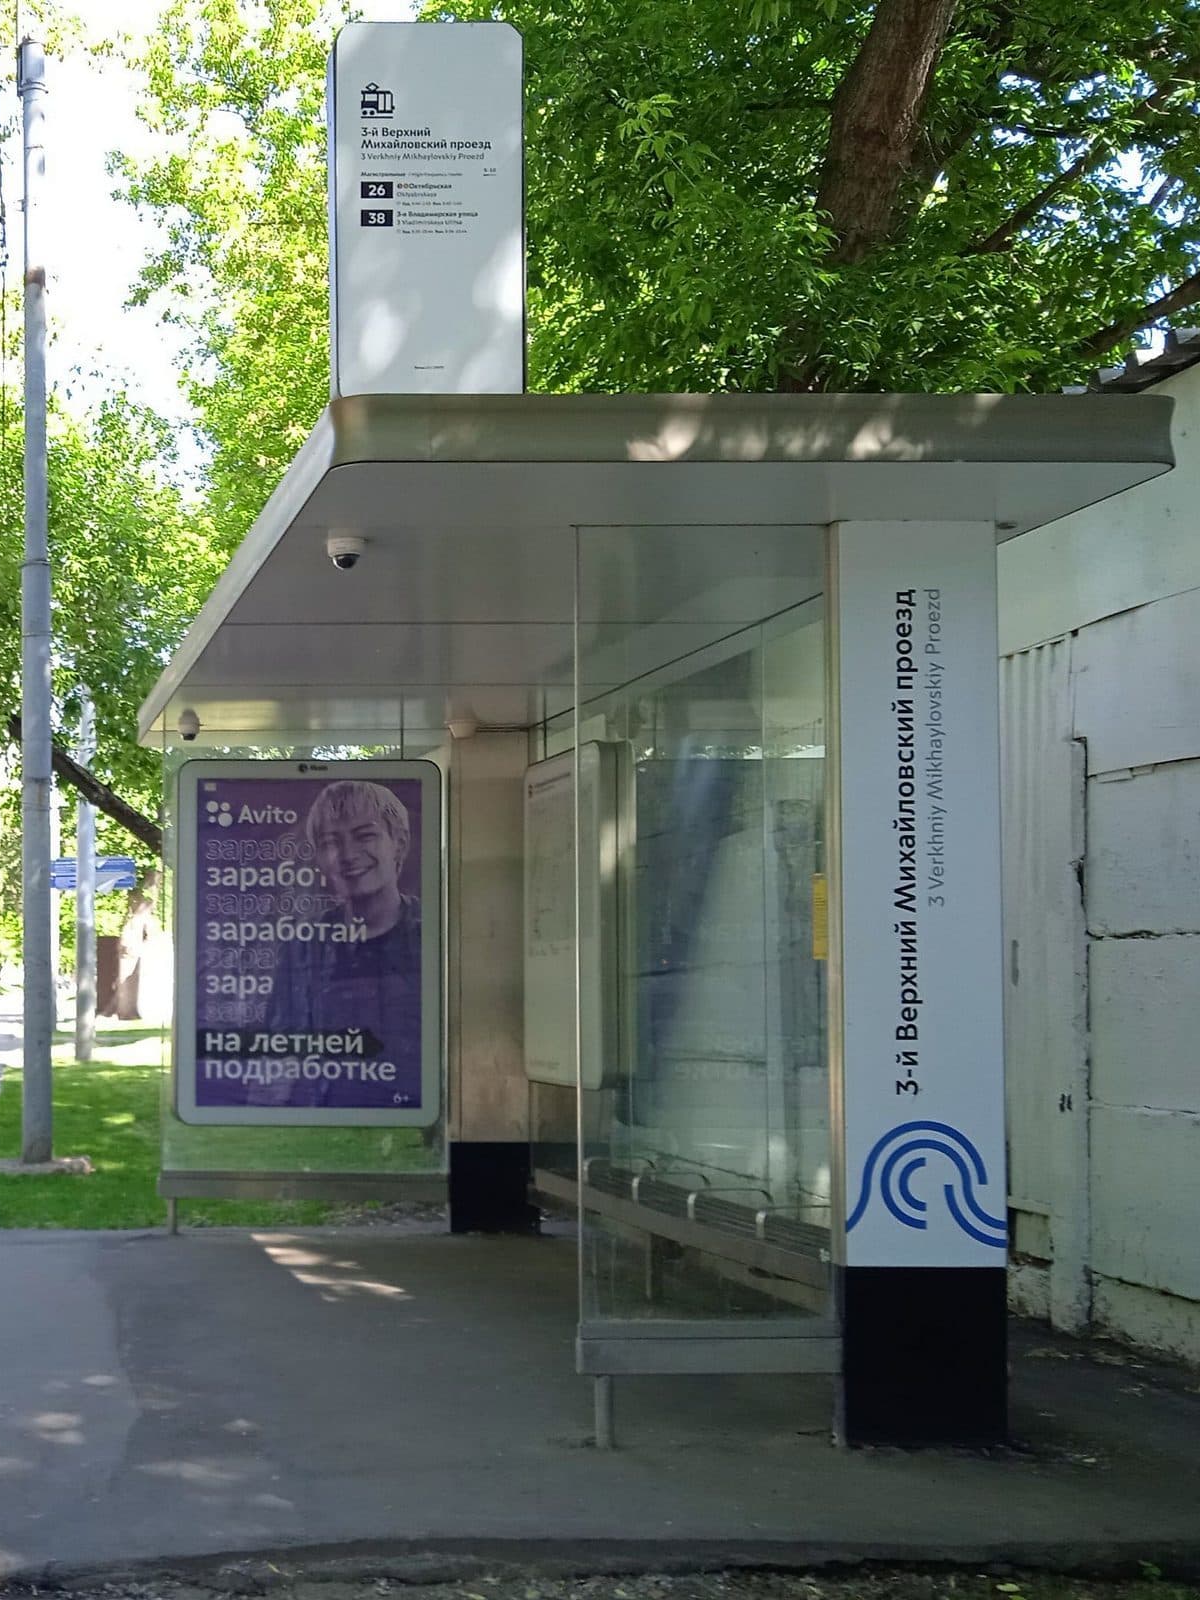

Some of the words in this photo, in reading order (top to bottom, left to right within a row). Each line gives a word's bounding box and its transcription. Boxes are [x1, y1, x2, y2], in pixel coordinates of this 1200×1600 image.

[360, 127, 378, 137] 3-й
[381, 127, 431, 138] Верхний
[360, 139, 447, 149] Михайловский
[449, 141, 492, 151] проезд
[367, 152, 401, 161] Verkhniy
[402, 152, 457, 161] Mikhaylovskiy
[458, 152, 485, 160] Proezd
[368, 184, 386, 196] 26
[368, 212, 386, 224] 38
[923, 588, 941, 655] Proezd
[895, 589, 918, 690] проезд
[924, 662, 947, 800] Mikhaylovskiy
[237, 804, 298, 825] Avito
[891, 699, 918, 913] Михайловский
[925, 805, 948, 890] Verkhniy
[928, 896, 945, 907] 3
[206, 916, 368, 946] заработай
[205, 974, 274, 999] зара
[894, 920, 923, 1041] Верхний
[205, 1031, 241, 1052] на
[249, 1028, 364, 1054] летней
[205, 1054, 397, 1085] подработке
[895, 1051, 919, 1096] 3-й
